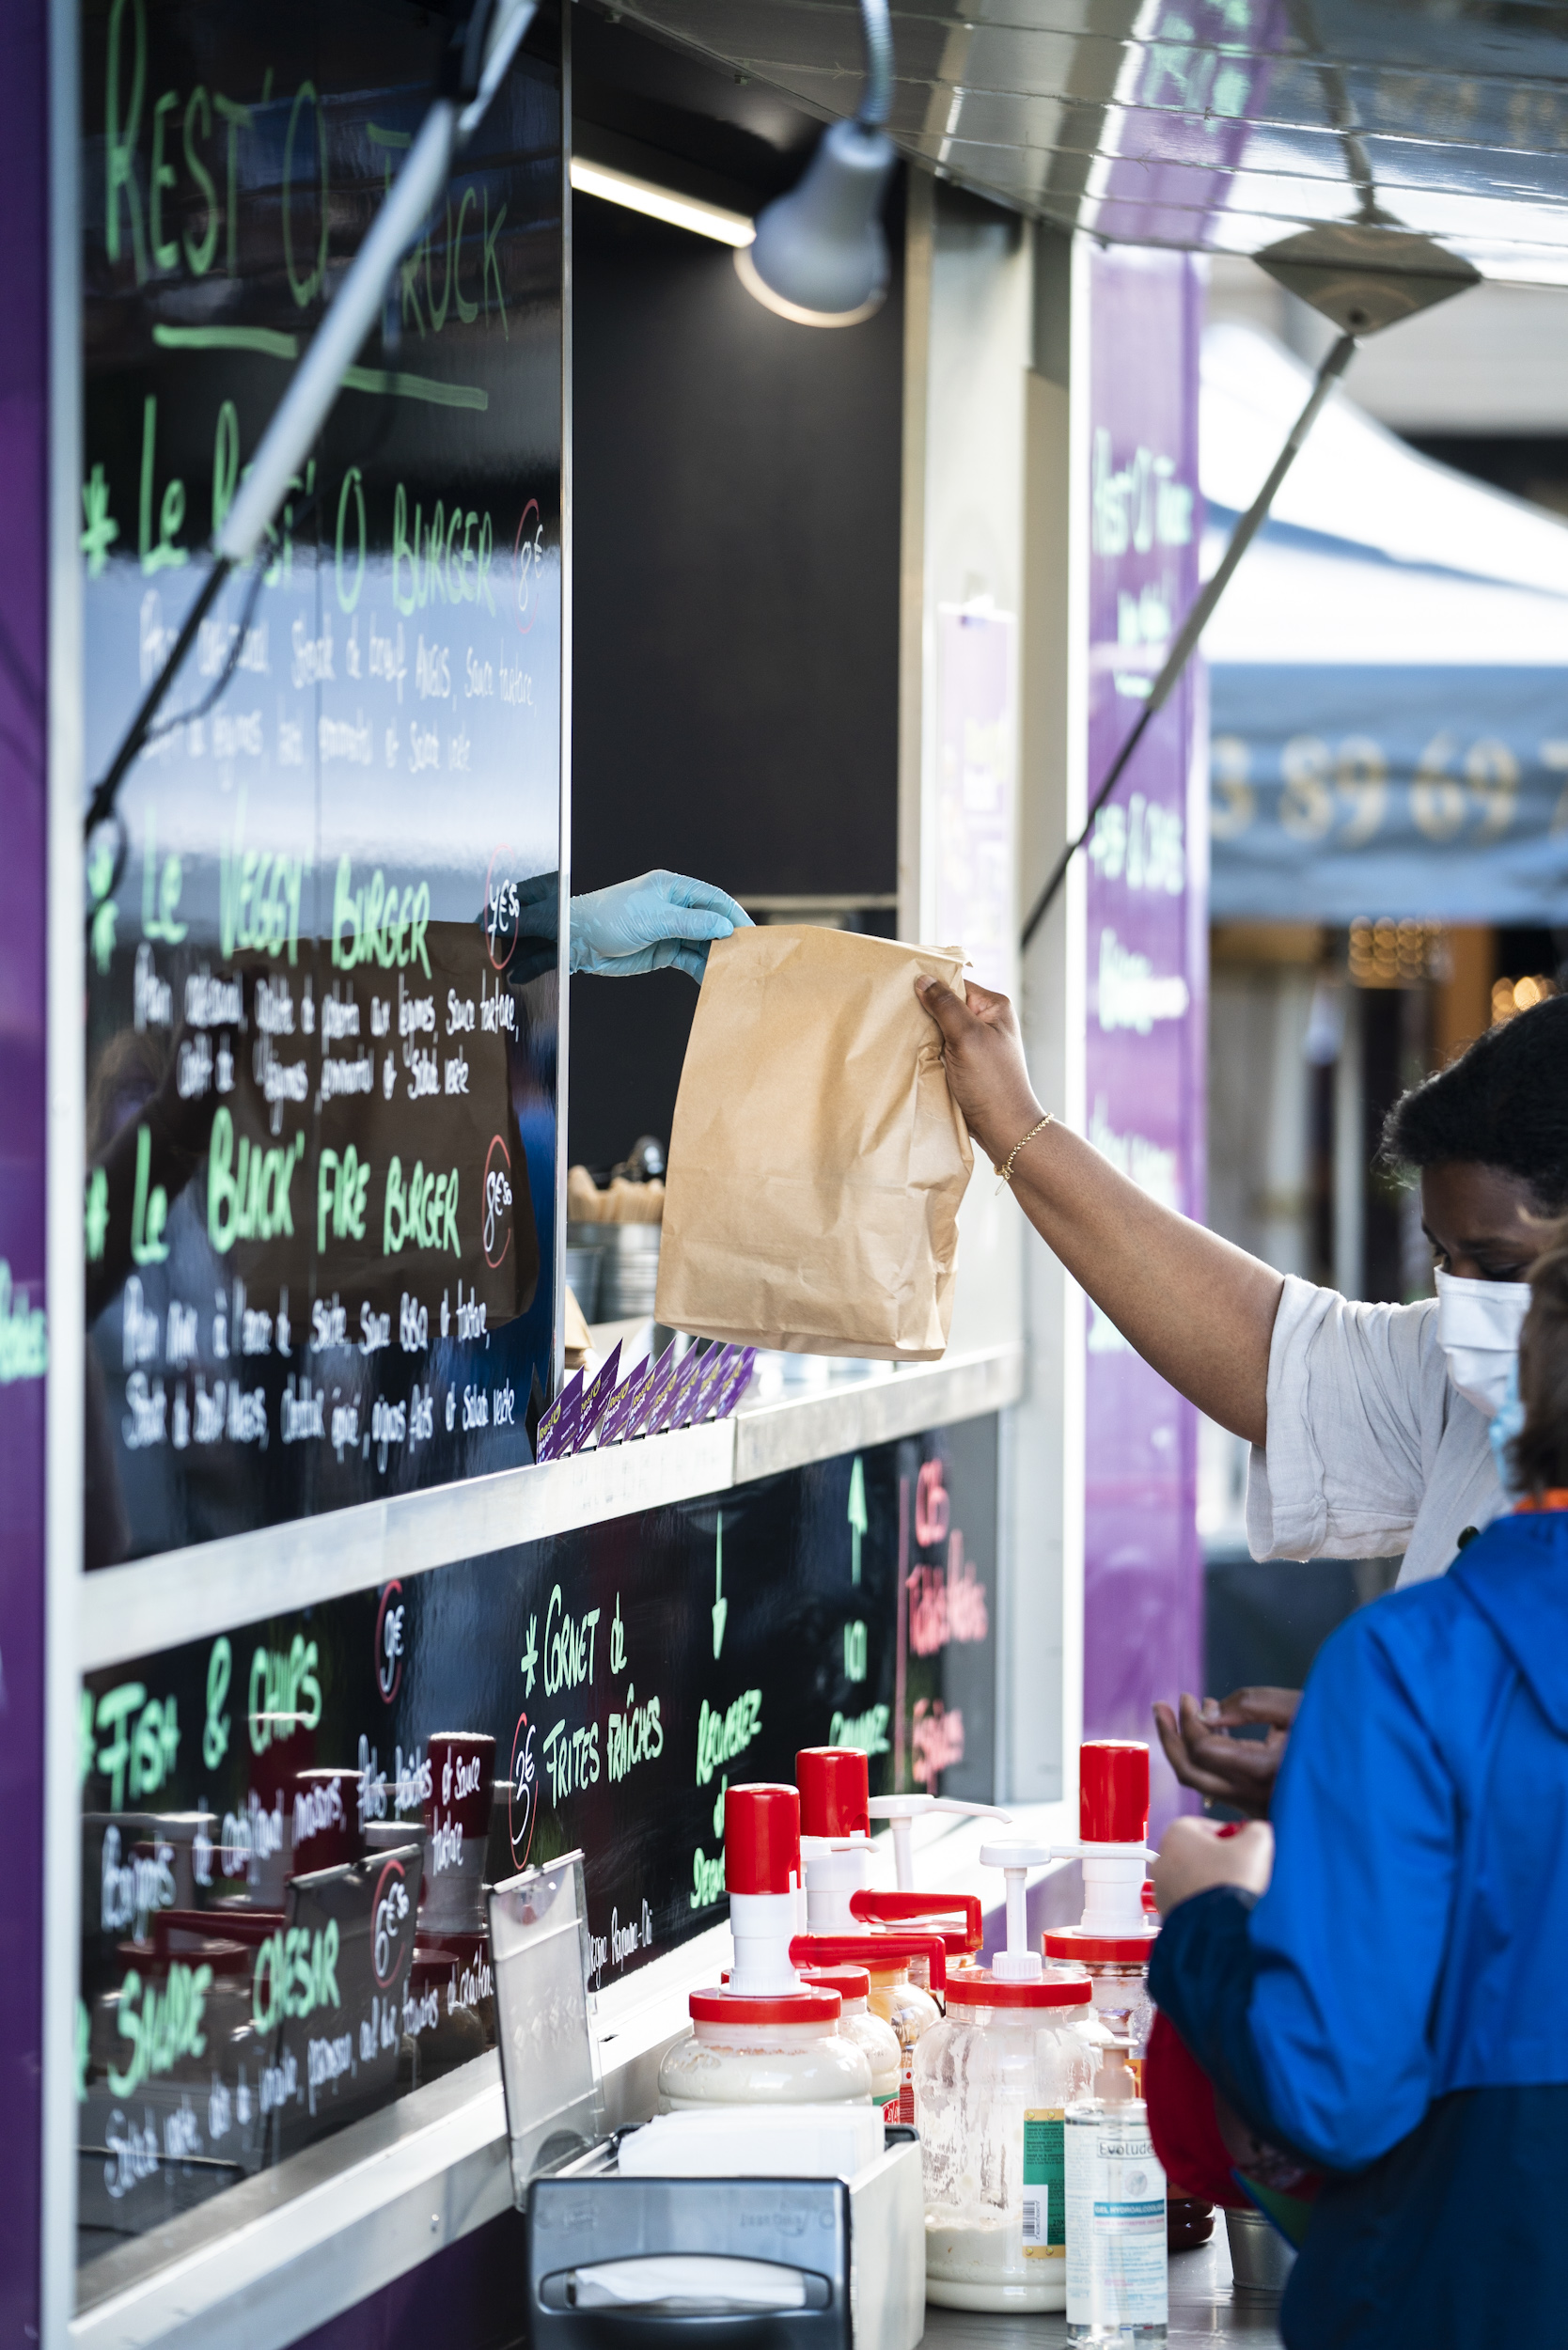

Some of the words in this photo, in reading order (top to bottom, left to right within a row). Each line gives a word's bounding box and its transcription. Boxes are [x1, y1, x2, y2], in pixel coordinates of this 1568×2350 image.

[394, 483, 495, 617] BURGER
[332, 854, 431, 979] BURGER
[318, 1144, 371, 1254] FIRE
[383, 1155, 462, 1258] BURGER
[543, 1584, 600, 1698] CORNET
[611, 1591, 628, 1673] de
[203, 1635, 232, 1771] &
[455, 1756, 481, 1800] Sauce
[543, 1719, 600, 1809] FRITES
